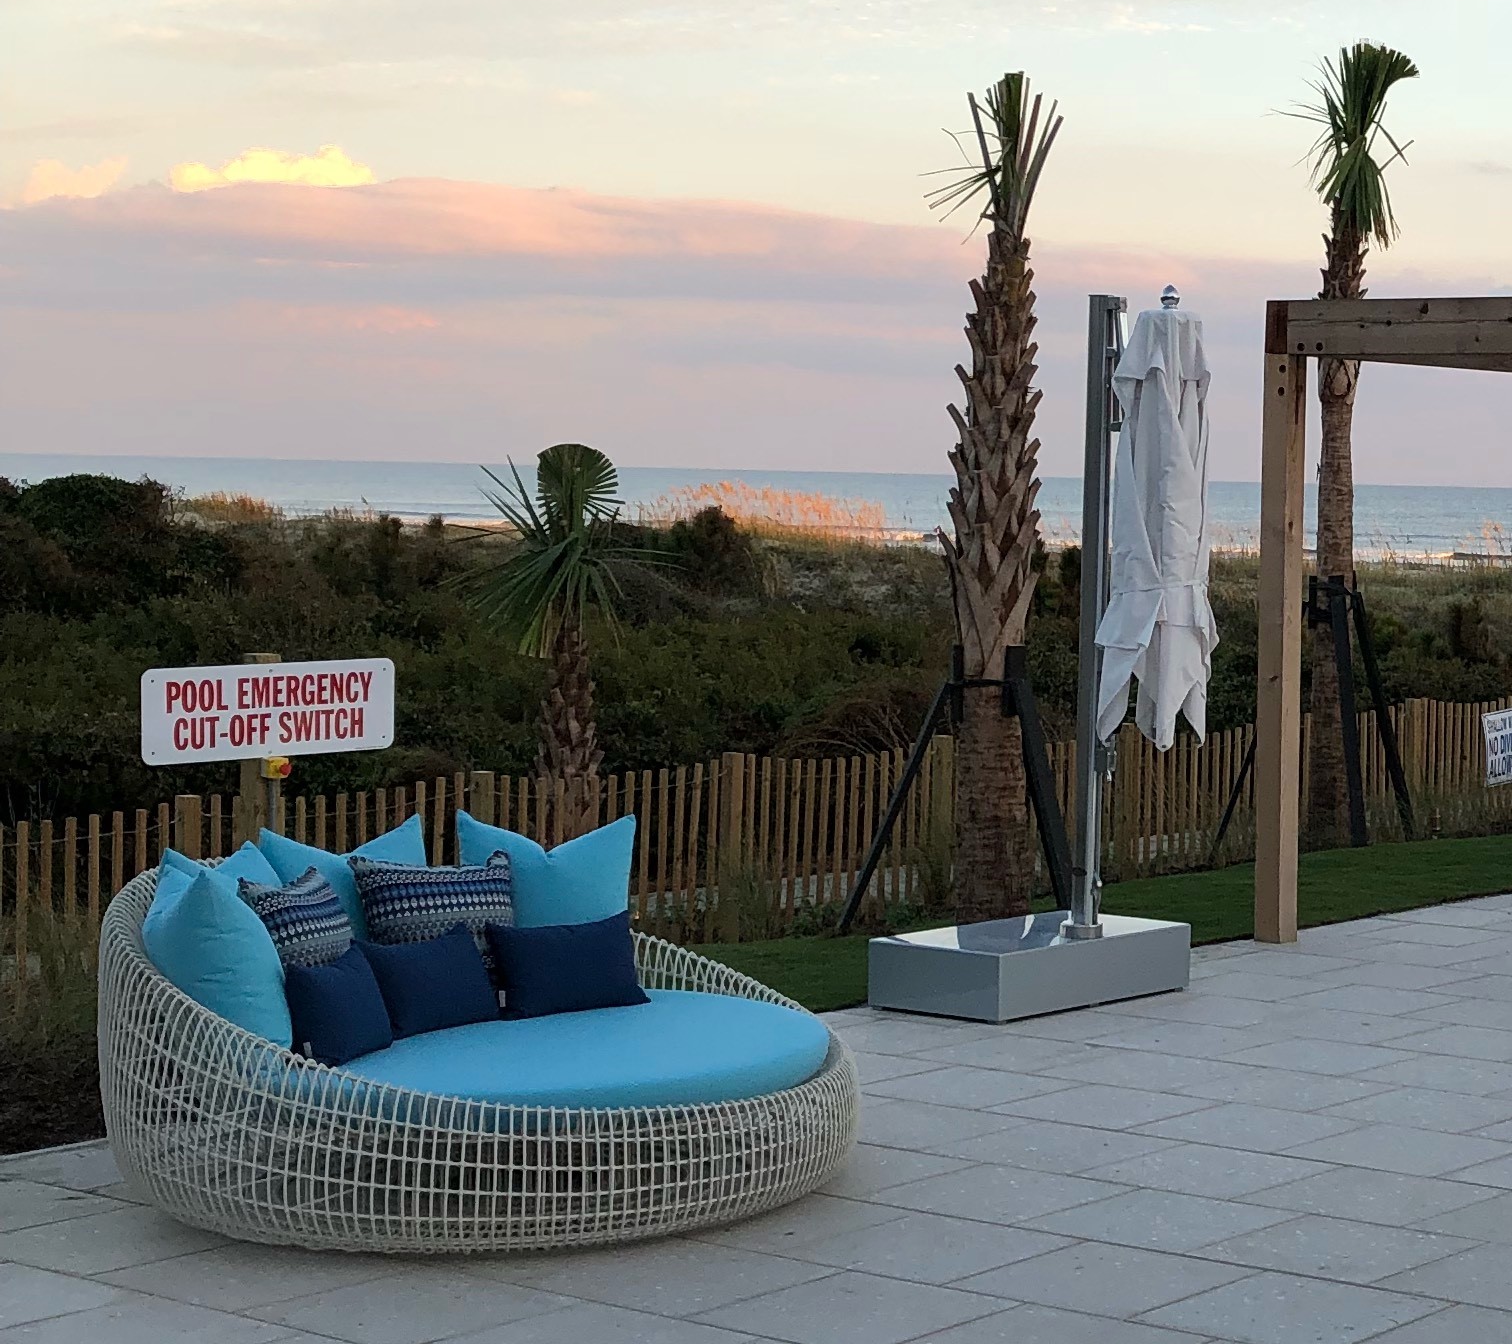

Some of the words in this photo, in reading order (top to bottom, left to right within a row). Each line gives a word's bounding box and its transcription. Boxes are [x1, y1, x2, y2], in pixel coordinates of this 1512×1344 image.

[166, 679, 229, 714] POOL
[237, 671, 373, 709] EMERGENCY
[173, 712, 272, 751] CUT-OFF
[278, 707, 364, 744] SWITCH
[1488, 736, 1498, 756] NO
